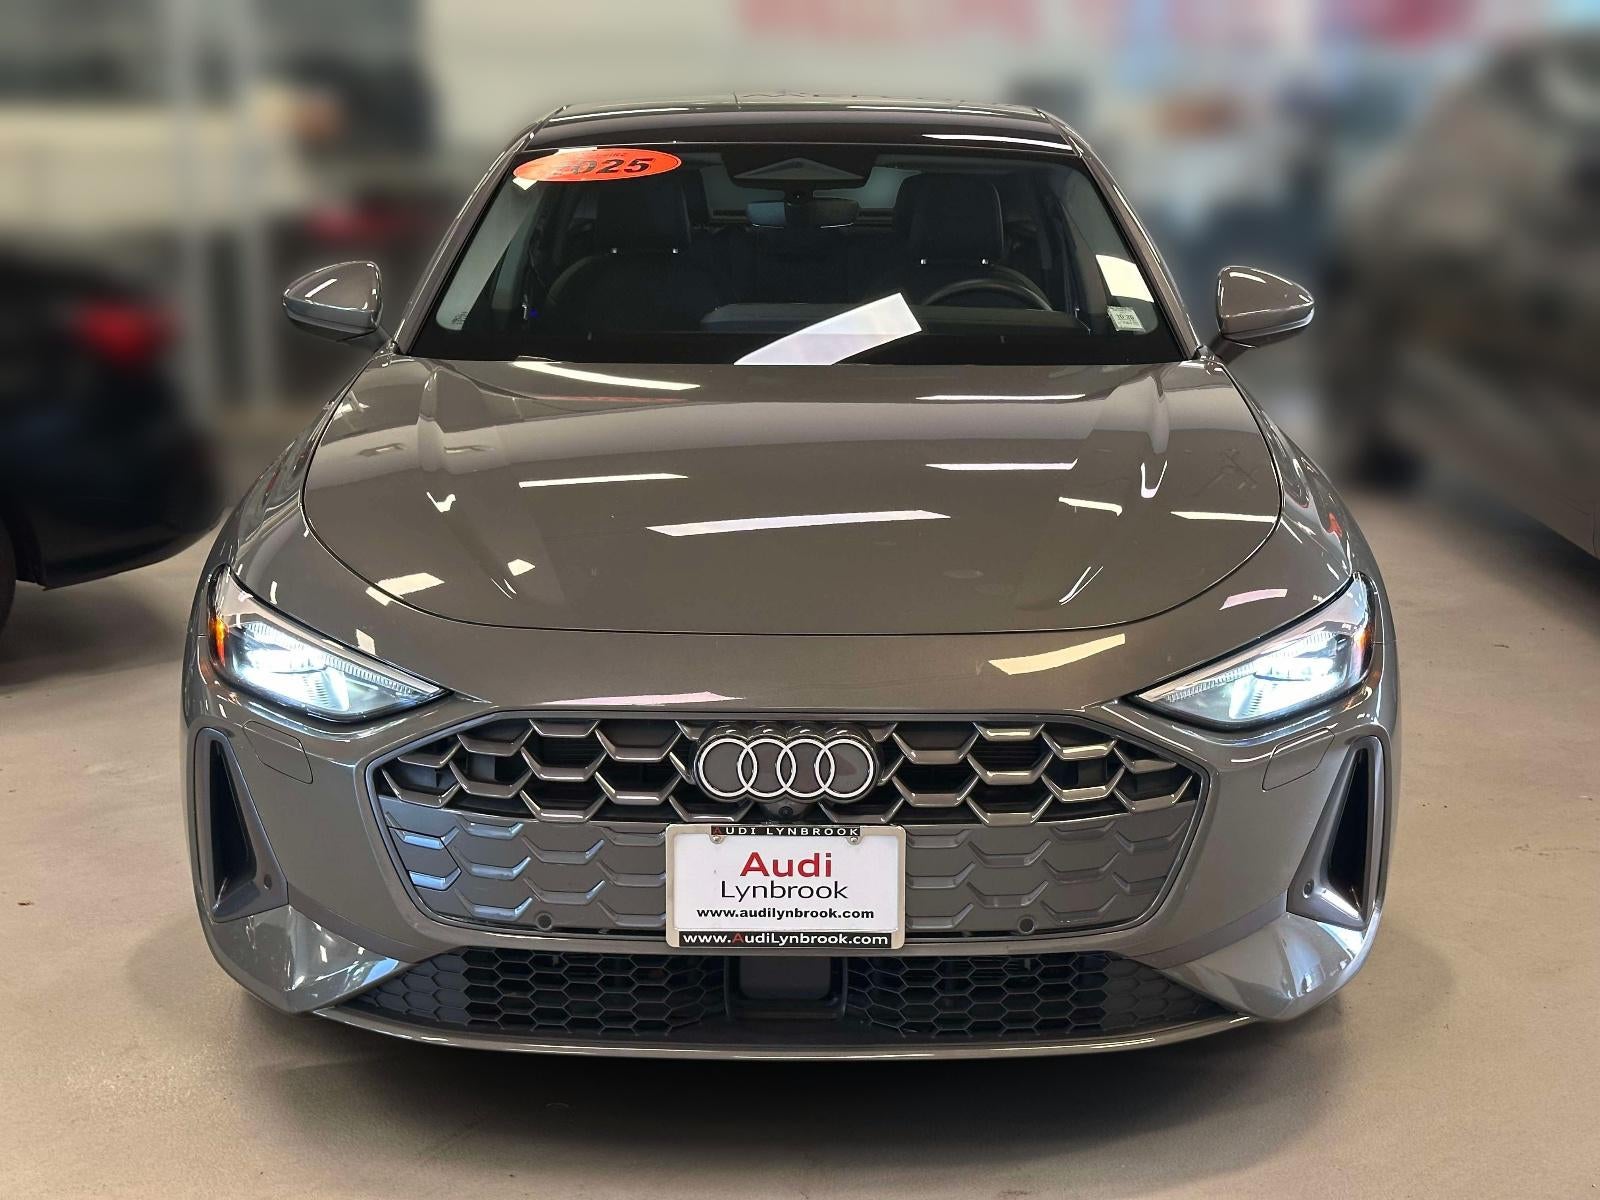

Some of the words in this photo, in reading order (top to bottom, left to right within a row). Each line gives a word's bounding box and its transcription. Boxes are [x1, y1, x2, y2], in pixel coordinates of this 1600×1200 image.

[713, 827, 756, 836] AUDI
[766, 827, 859, 836] LYNBROOK
[740, 852, 832, 877] Audi
[721, 880, 848, 902] Lynbrook
[697, 908, 874, 920] www.audilynbrook.com
[683, 932, 888, 945] www.AudiLynbrook.com
